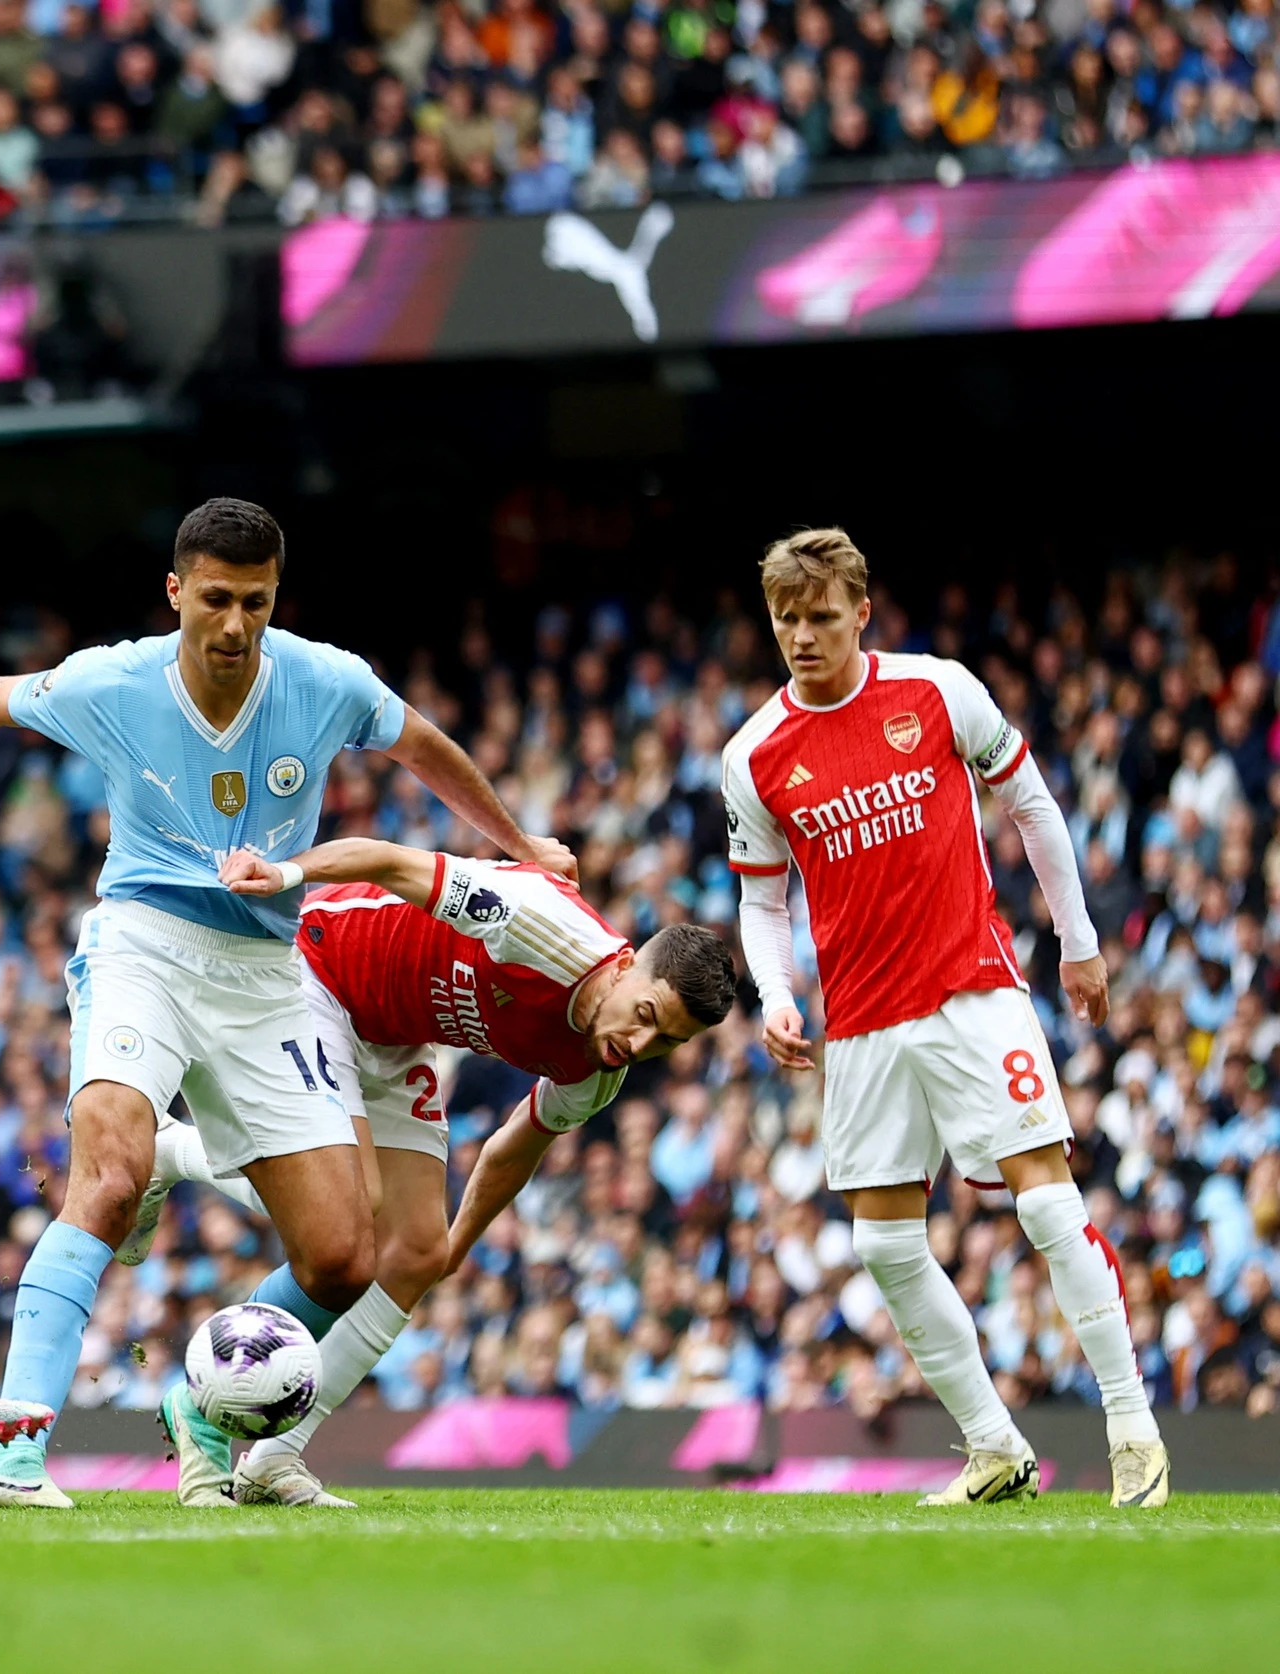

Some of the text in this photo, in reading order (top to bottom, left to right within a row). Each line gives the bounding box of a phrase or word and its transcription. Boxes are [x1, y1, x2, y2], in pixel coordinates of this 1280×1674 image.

[222, 799, 239, 807] FIFA
[790, 765, 937, 840] Emirates
[823, 802, 925, 863] FLY BETTER
[442, 883, 459, 915] racism
[450, 886, 466, 913] room
[405, 1064, 442, 1121] 2
[1002, 1048, 1045, 1103] 8
[15, 1309, 40, 1320] ITY
